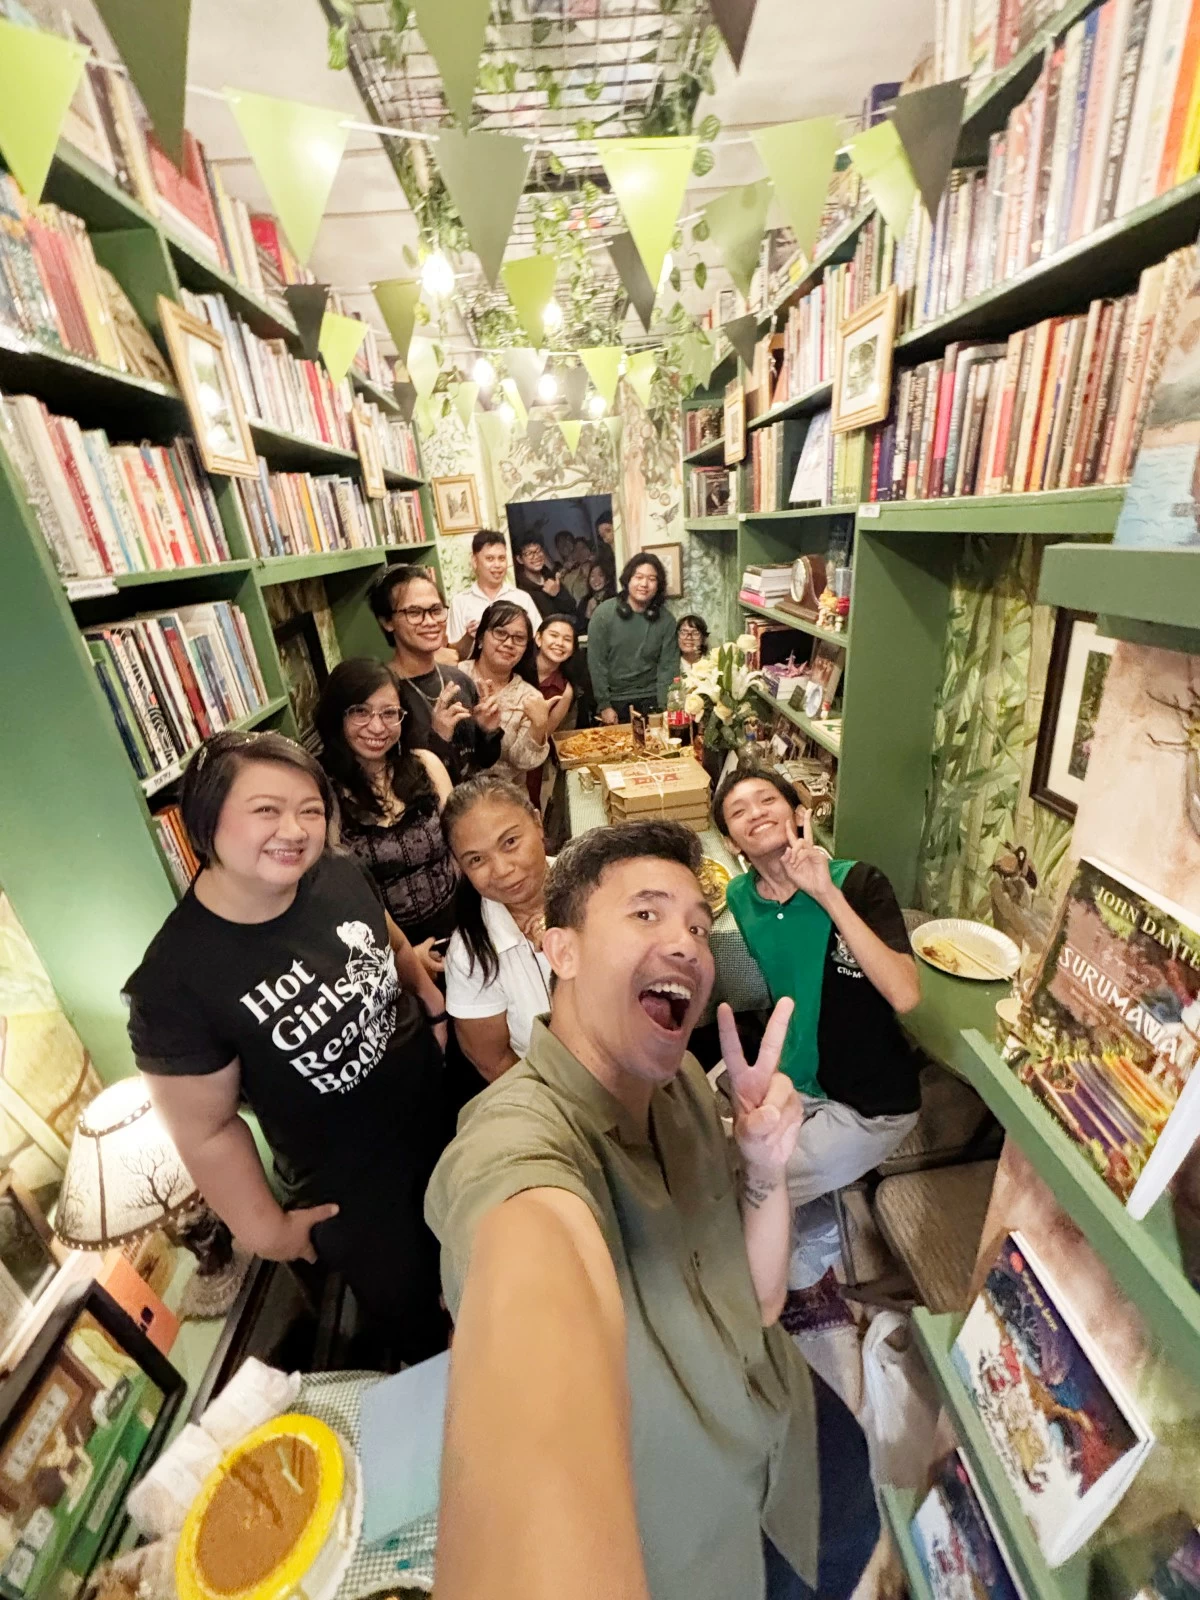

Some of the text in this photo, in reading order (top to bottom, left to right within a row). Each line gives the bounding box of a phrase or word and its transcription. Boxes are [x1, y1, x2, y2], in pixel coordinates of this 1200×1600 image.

[1096, 886, 1140, 925] JOHN
[239, 958, 315, 1025] Hot
[272, 976, 359, 1051] Girls
[338, 1077, 360, 1095] THE
[362, 1050, 384, 1078] BABE
